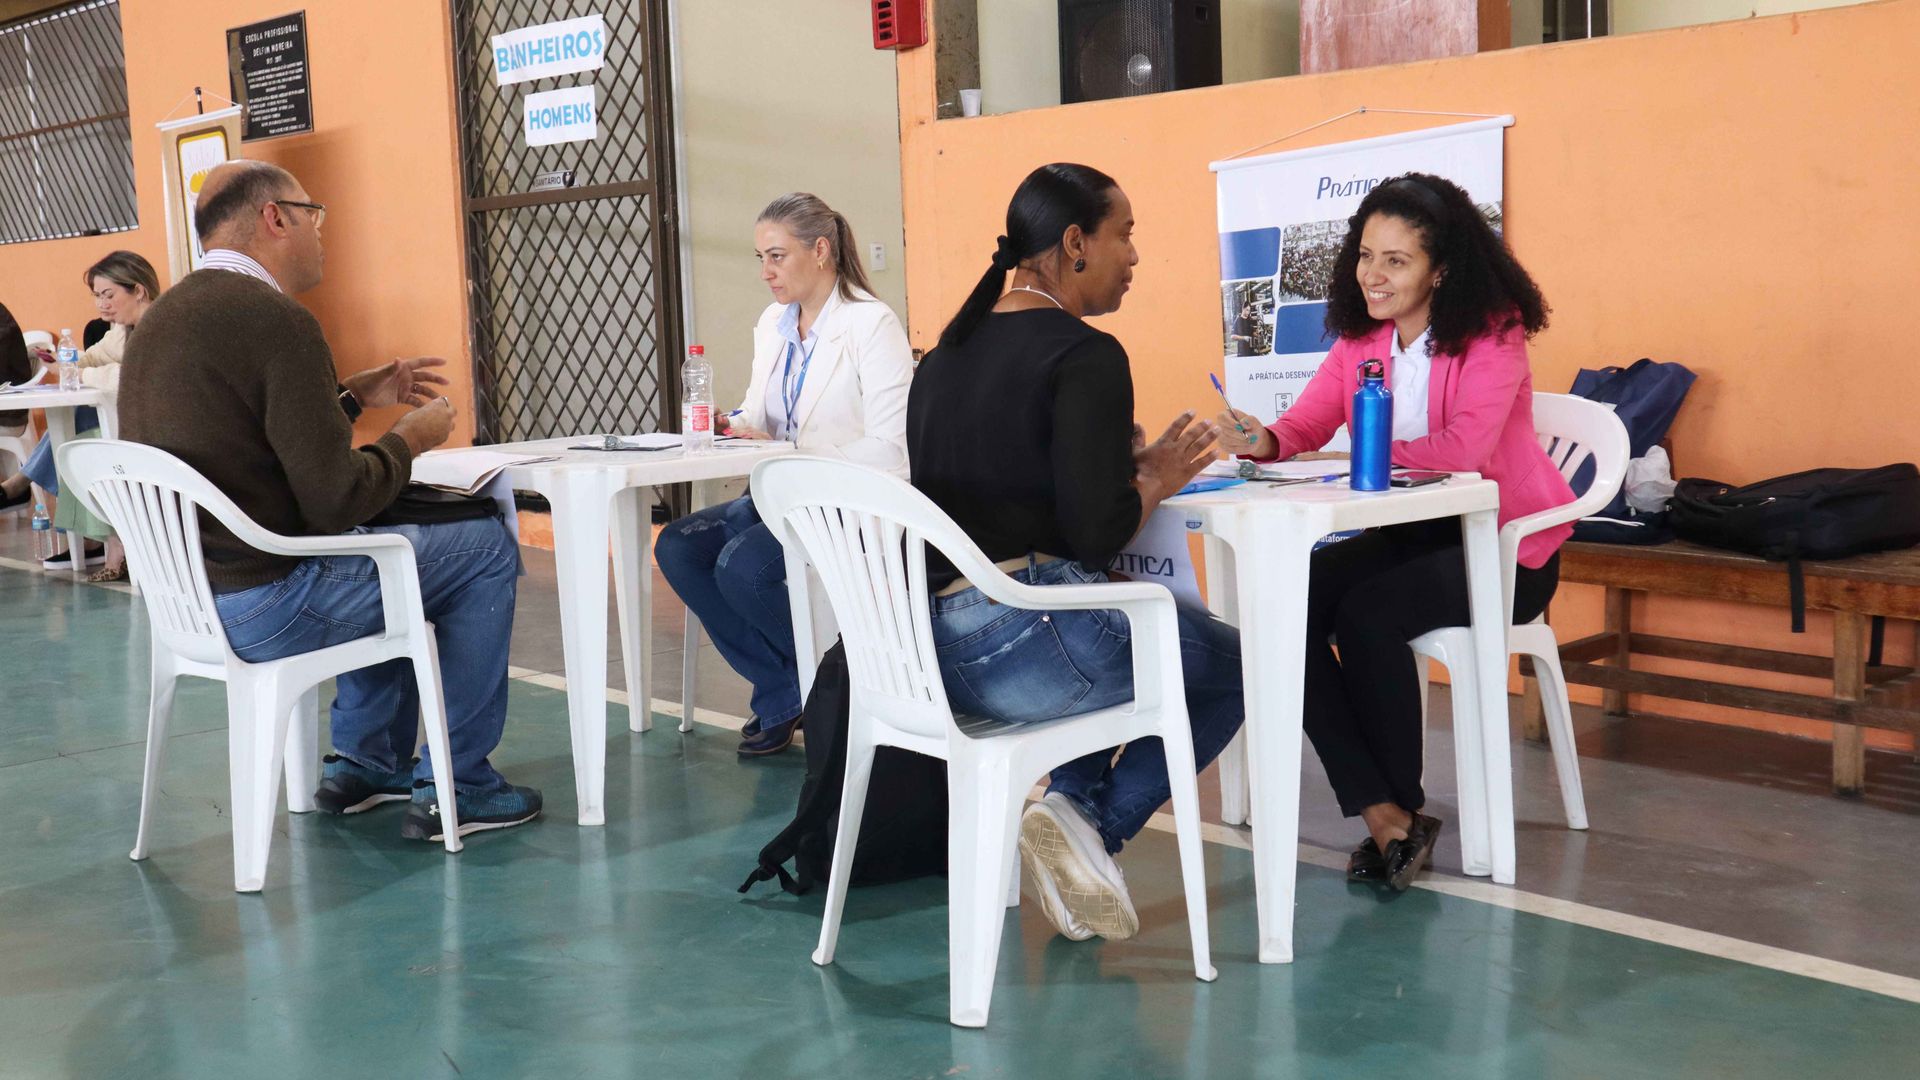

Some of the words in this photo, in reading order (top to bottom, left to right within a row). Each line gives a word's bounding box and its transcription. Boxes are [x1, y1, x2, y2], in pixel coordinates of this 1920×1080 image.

[245, 32, 263, 44] ESCOLA
[264, 24, 299, 38] PROFISSIONAL
[271, 40, 293, 52] MOREIRA
[496, 28, 603, 72] BANHEIROS
[529, 102, 592, 130] HOMENS
[1317, 174, 1379, 200] PRÁTIC
[1249, 373, 1254, 381] A
[1255, 371, 1284, 380] PRÁTICA
[1285, 370, 1317, 379] DESENVO
